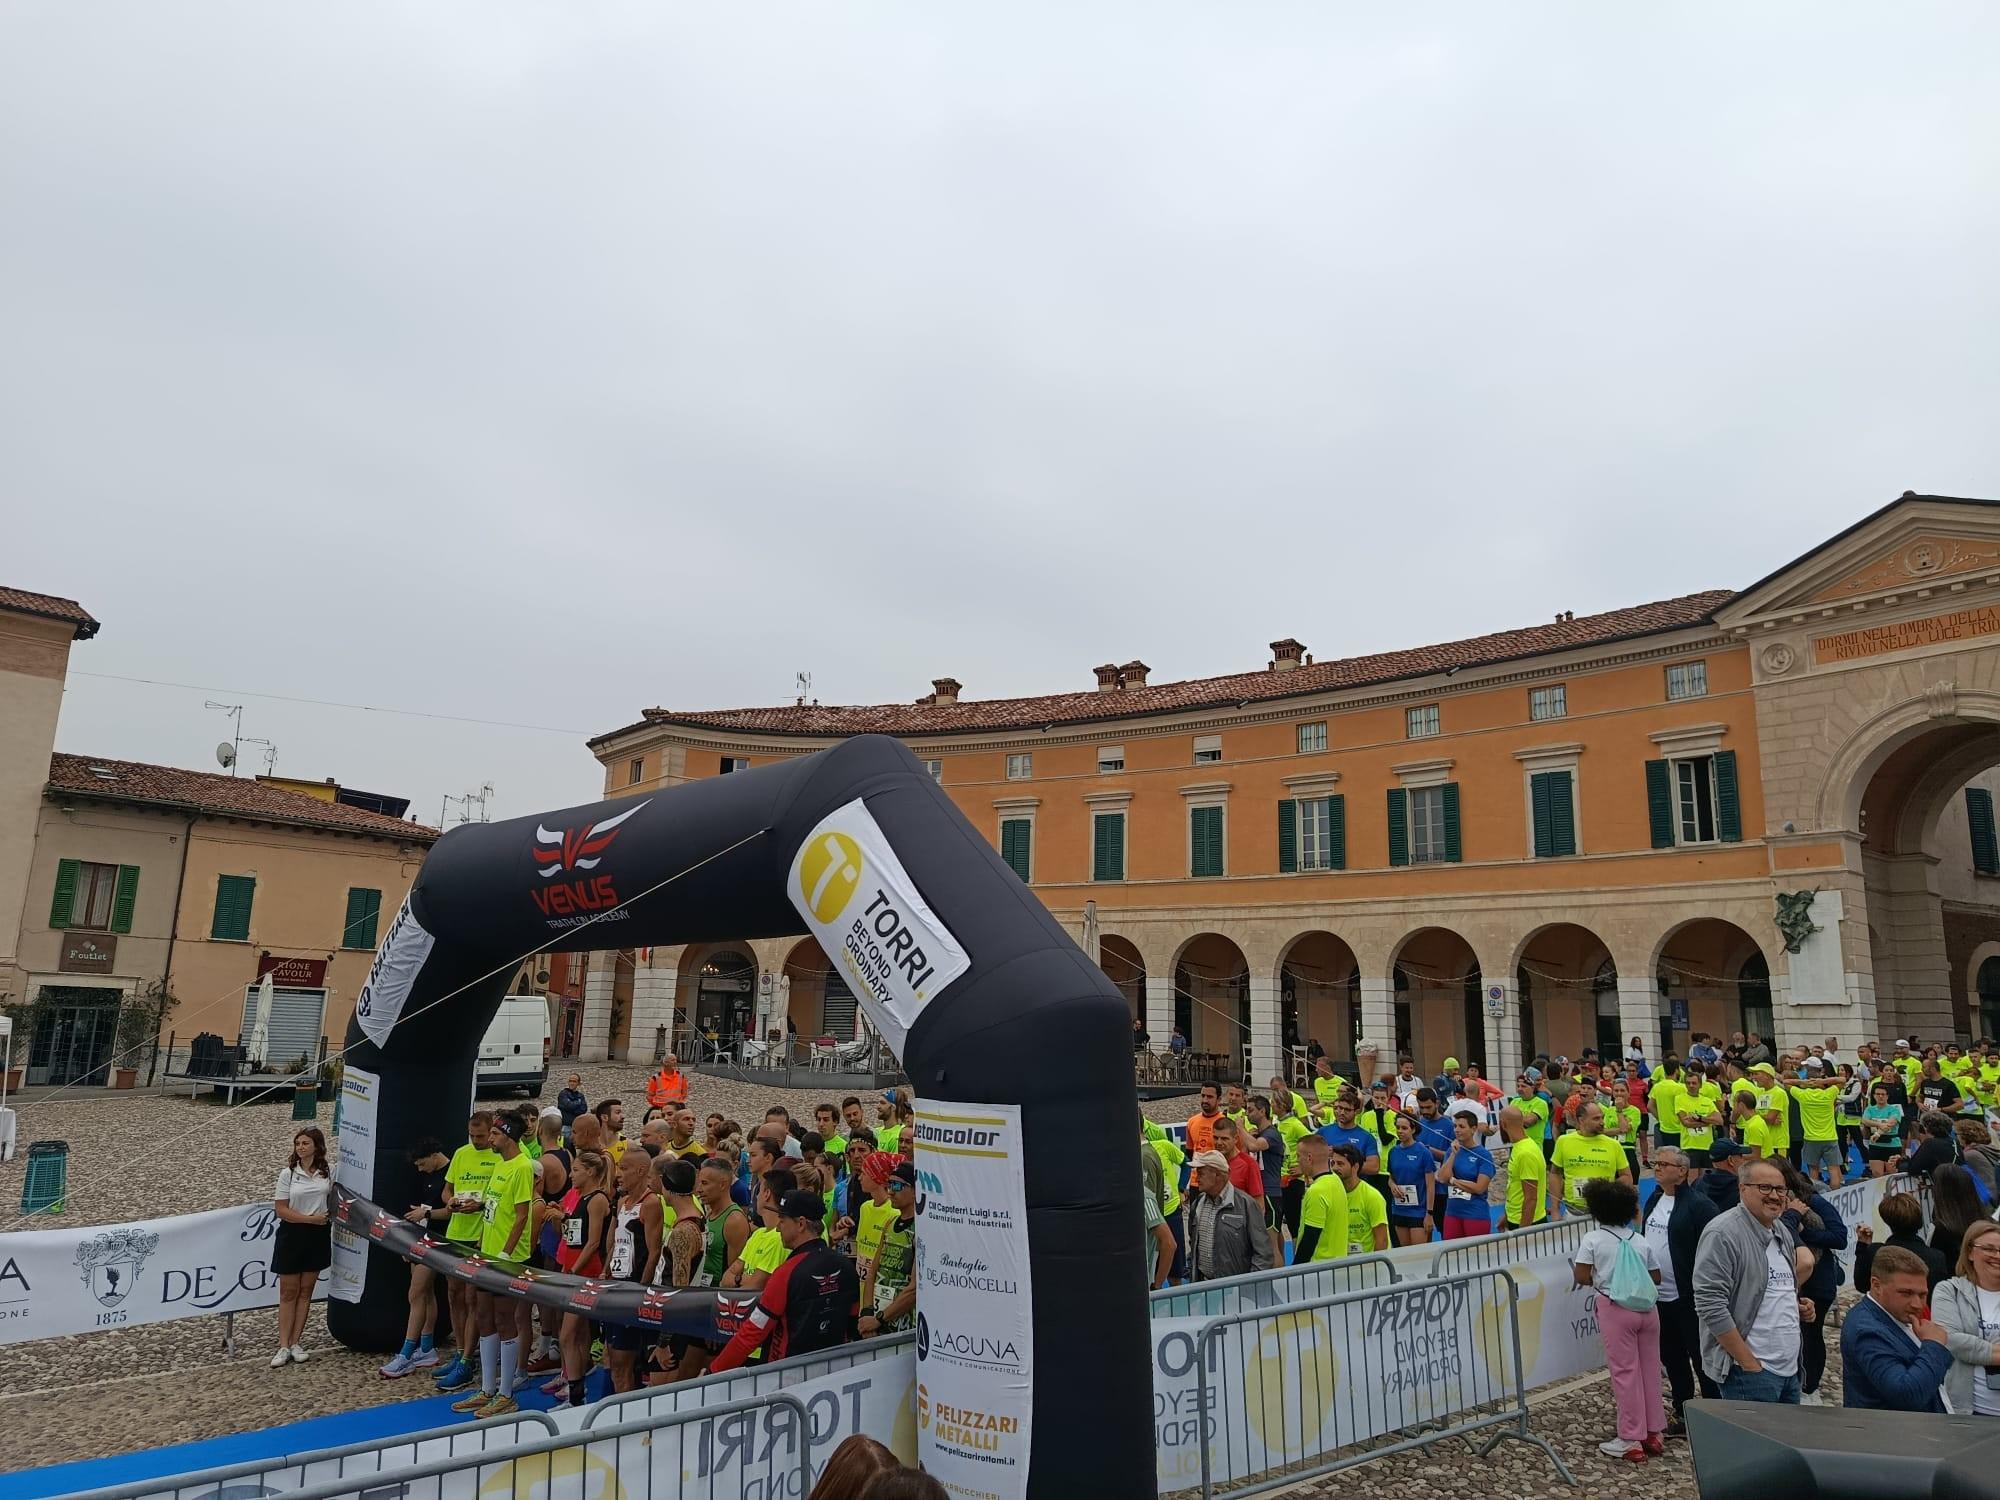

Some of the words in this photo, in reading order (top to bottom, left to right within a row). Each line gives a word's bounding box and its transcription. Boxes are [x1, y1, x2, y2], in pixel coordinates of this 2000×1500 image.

[1949, 608, 1996, 626] DELLA
[1836, 643, 1876, 659] RIVIVO
[1879, 634, 1923, 651] NELLA
[1929, 626, 1961, 642] LUCE
[531, 875, 619, 916] VENUS
[851, 918, 892, 979] BEYOND
[271, 969, 312, 978] CAVOUR
[278, 961, 311, 970] RIONE
[845, 934, 893, 1004] ORDINARY
[342, 1080, 369, 1095] color
[970, 1207, 991, 1219] Luigi
[968, 1218, 1013, 1229] Industriali
[612, 1259, 622, 1272] 22
[940, 1252, 989, 1275] Barboglio
[161, 1266, 217, 1303] DE
[927, 1268, 937, 1282] DE
[934, 1272, 1017, 1295] GAIONCELLI
[95, 1310, 128, 1326] 1875
[715, 1316, 743, 1331] VENU
[936, 1403, 1019, 1434] PELIZZARI
[935, 1421, 999, 1452] METALLI
